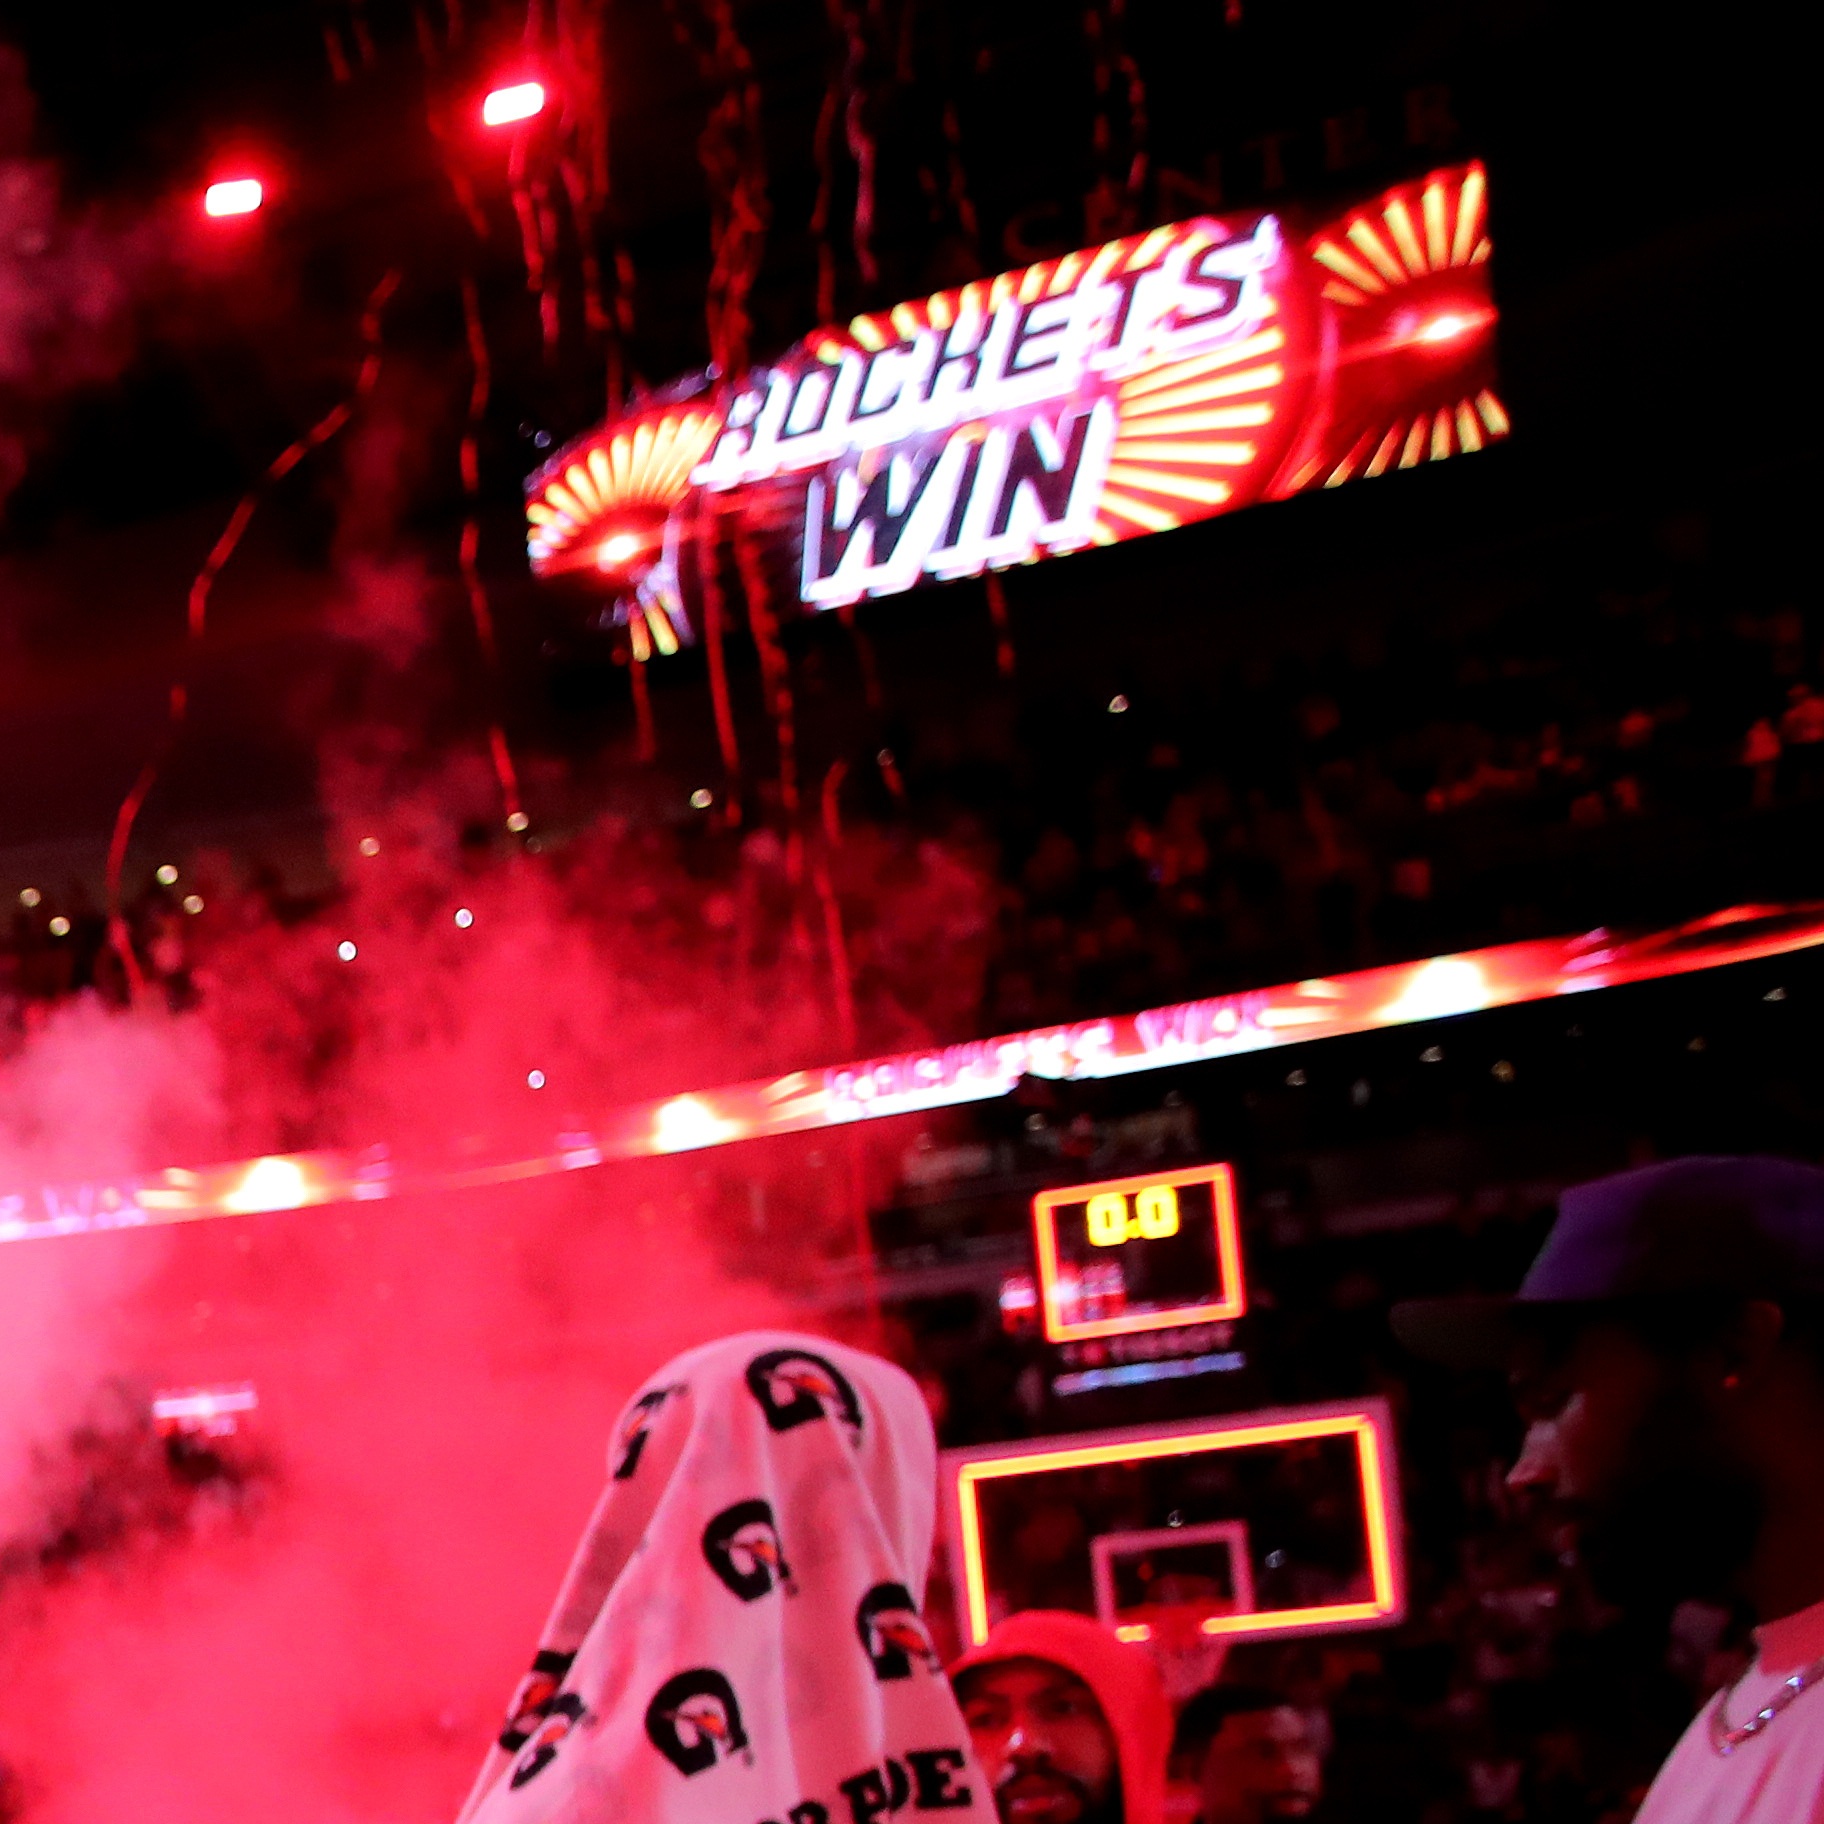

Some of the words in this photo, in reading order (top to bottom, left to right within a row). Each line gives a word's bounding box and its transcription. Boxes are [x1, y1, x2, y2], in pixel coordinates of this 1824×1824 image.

[688, 213, 1282, 492] ROCKETS
[798, 396, 1120, 610] WIN
[1086, 1183, 1180, 1248] 0.0
